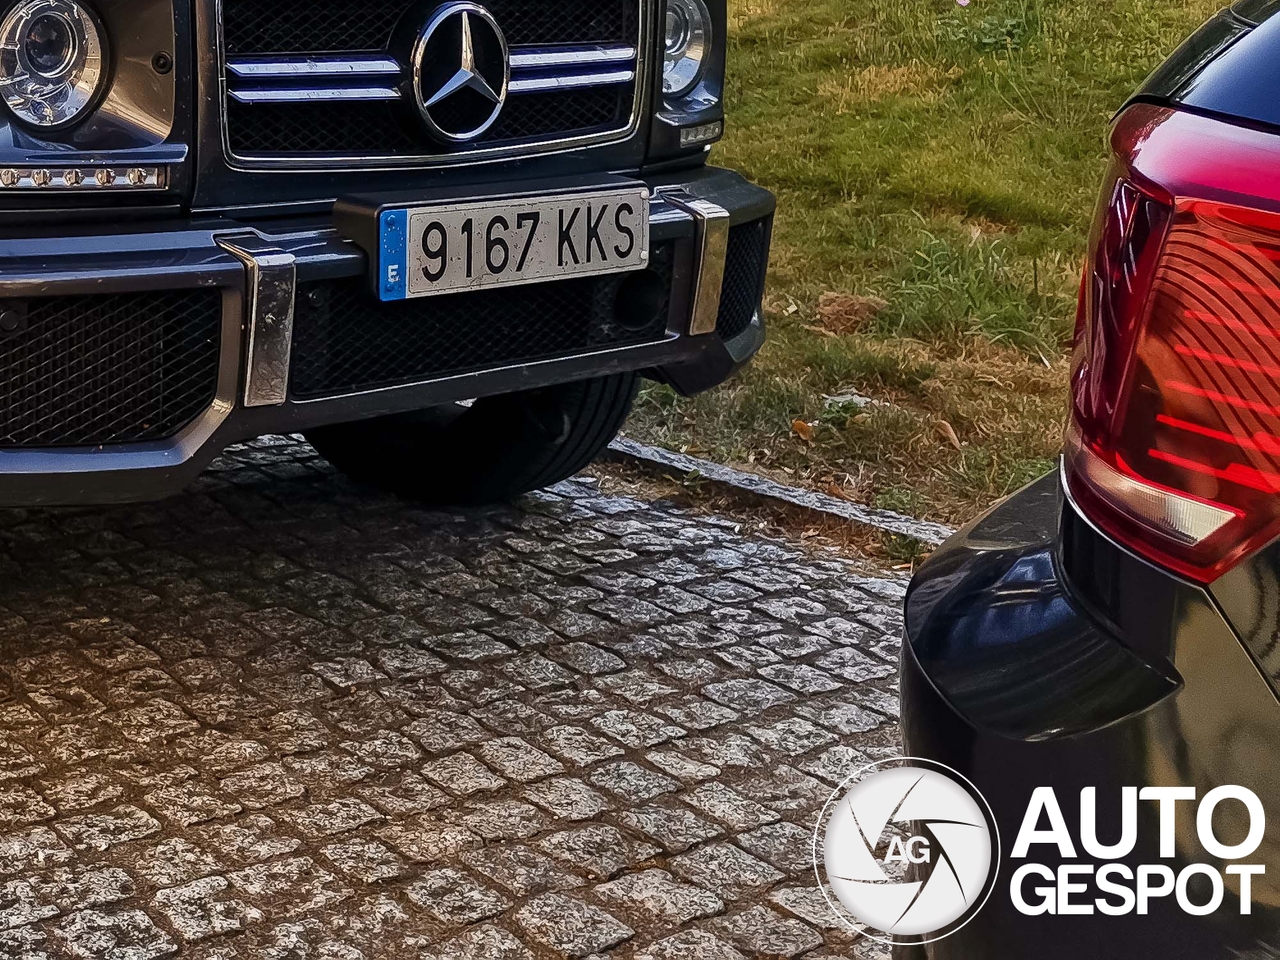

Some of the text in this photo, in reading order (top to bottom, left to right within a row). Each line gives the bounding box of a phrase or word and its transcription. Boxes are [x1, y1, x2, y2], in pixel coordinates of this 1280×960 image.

[421, 203, 634, 282] 9167 KKS
[388, 264, 399, 282] E
